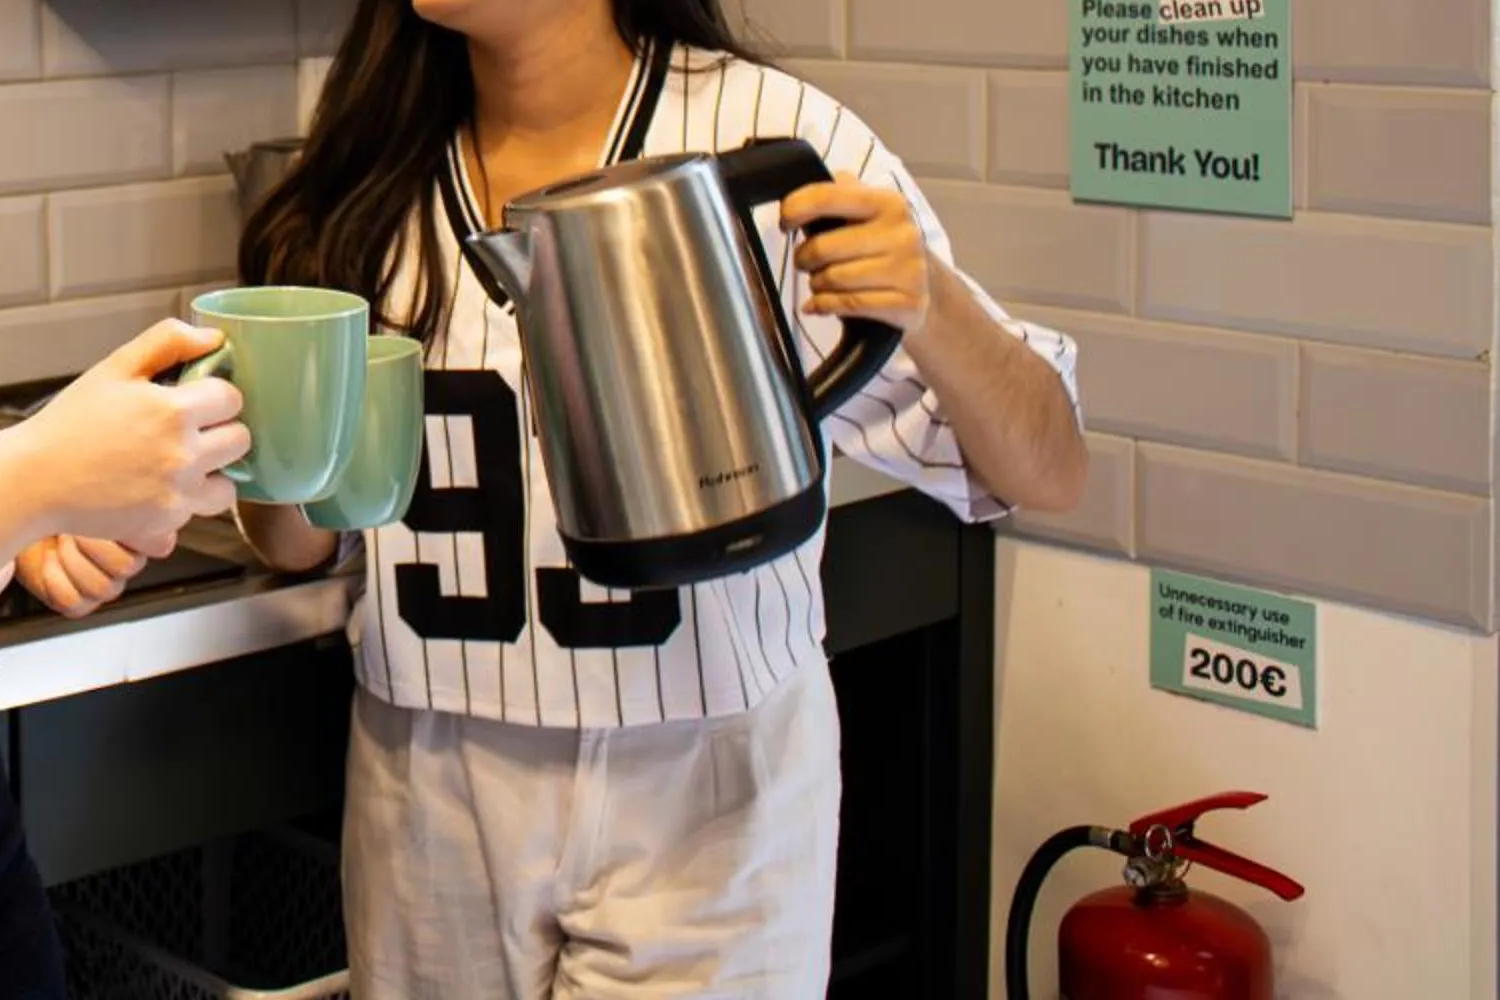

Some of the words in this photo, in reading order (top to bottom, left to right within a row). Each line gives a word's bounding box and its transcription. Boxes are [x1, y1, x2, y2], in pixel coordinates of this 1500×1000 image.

[1159, 0, 1222, 20] clean
[1082, 27, 1130, 47] your
[1136, 25, 1210, 46] dishes
[1216, 28, 1278, 48] when
[1082, 55, 1121, 76] you
[1128, 54, 1179, 75] have
[1186, 56, 1278, 79] finished
[1082, 82, 1102, 103] in
[1109, 83, 1145, 105] the
[1152, 85, 1240, 110] kitchen
[1094, 143, 1185, 175] Thank
[1193, 149, 1260, 181] You!
[1159, 583, 1258, 621] Unnecessary
[1262, 608, 1289, 625] use
[1159, 604, 1175, 619] of
[1179, 606, 1204, 625] fire
[1208, 618, 1306, 649] extinguisher
[1190, 648, 1287, 697] 200€
